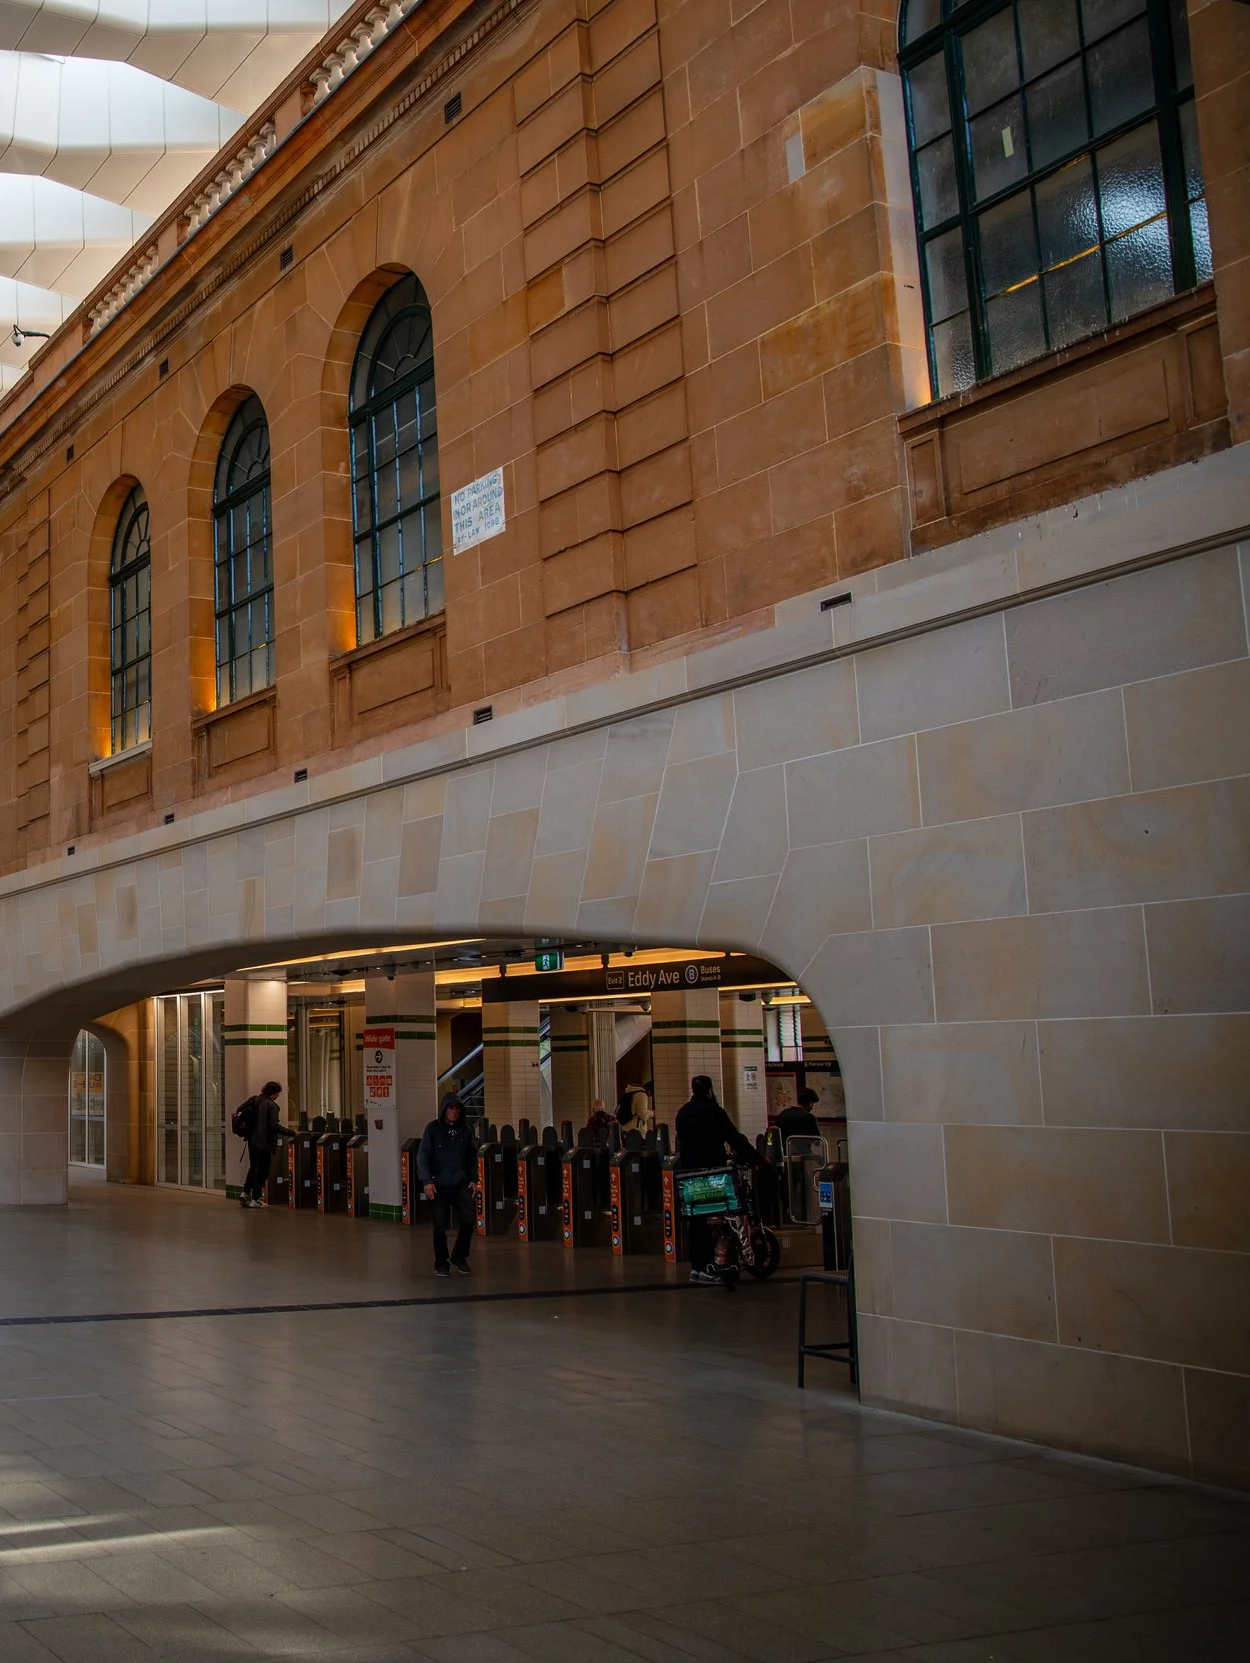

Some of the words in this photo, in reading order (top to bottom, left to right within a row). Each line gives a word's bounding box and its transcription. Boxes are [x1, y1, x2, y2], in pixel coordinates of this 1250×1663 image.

[454, 491, 465, 505] NO
[467, 475, 497, 498] PARKING
[472, 486, 503, 510] AROUND
[454, 517, 472, 534] THIS
[479, 502, 500, 522] AREA
[608, 977, 618, 985] Exit
[628, 970, 656, 989] Eddy
[658, 969, 680, 984] Ave
[700, 965, 721, 974] Buses
[365, 1034, 377, 1042] Wide
[378, 1034, 391, 1044] gate
